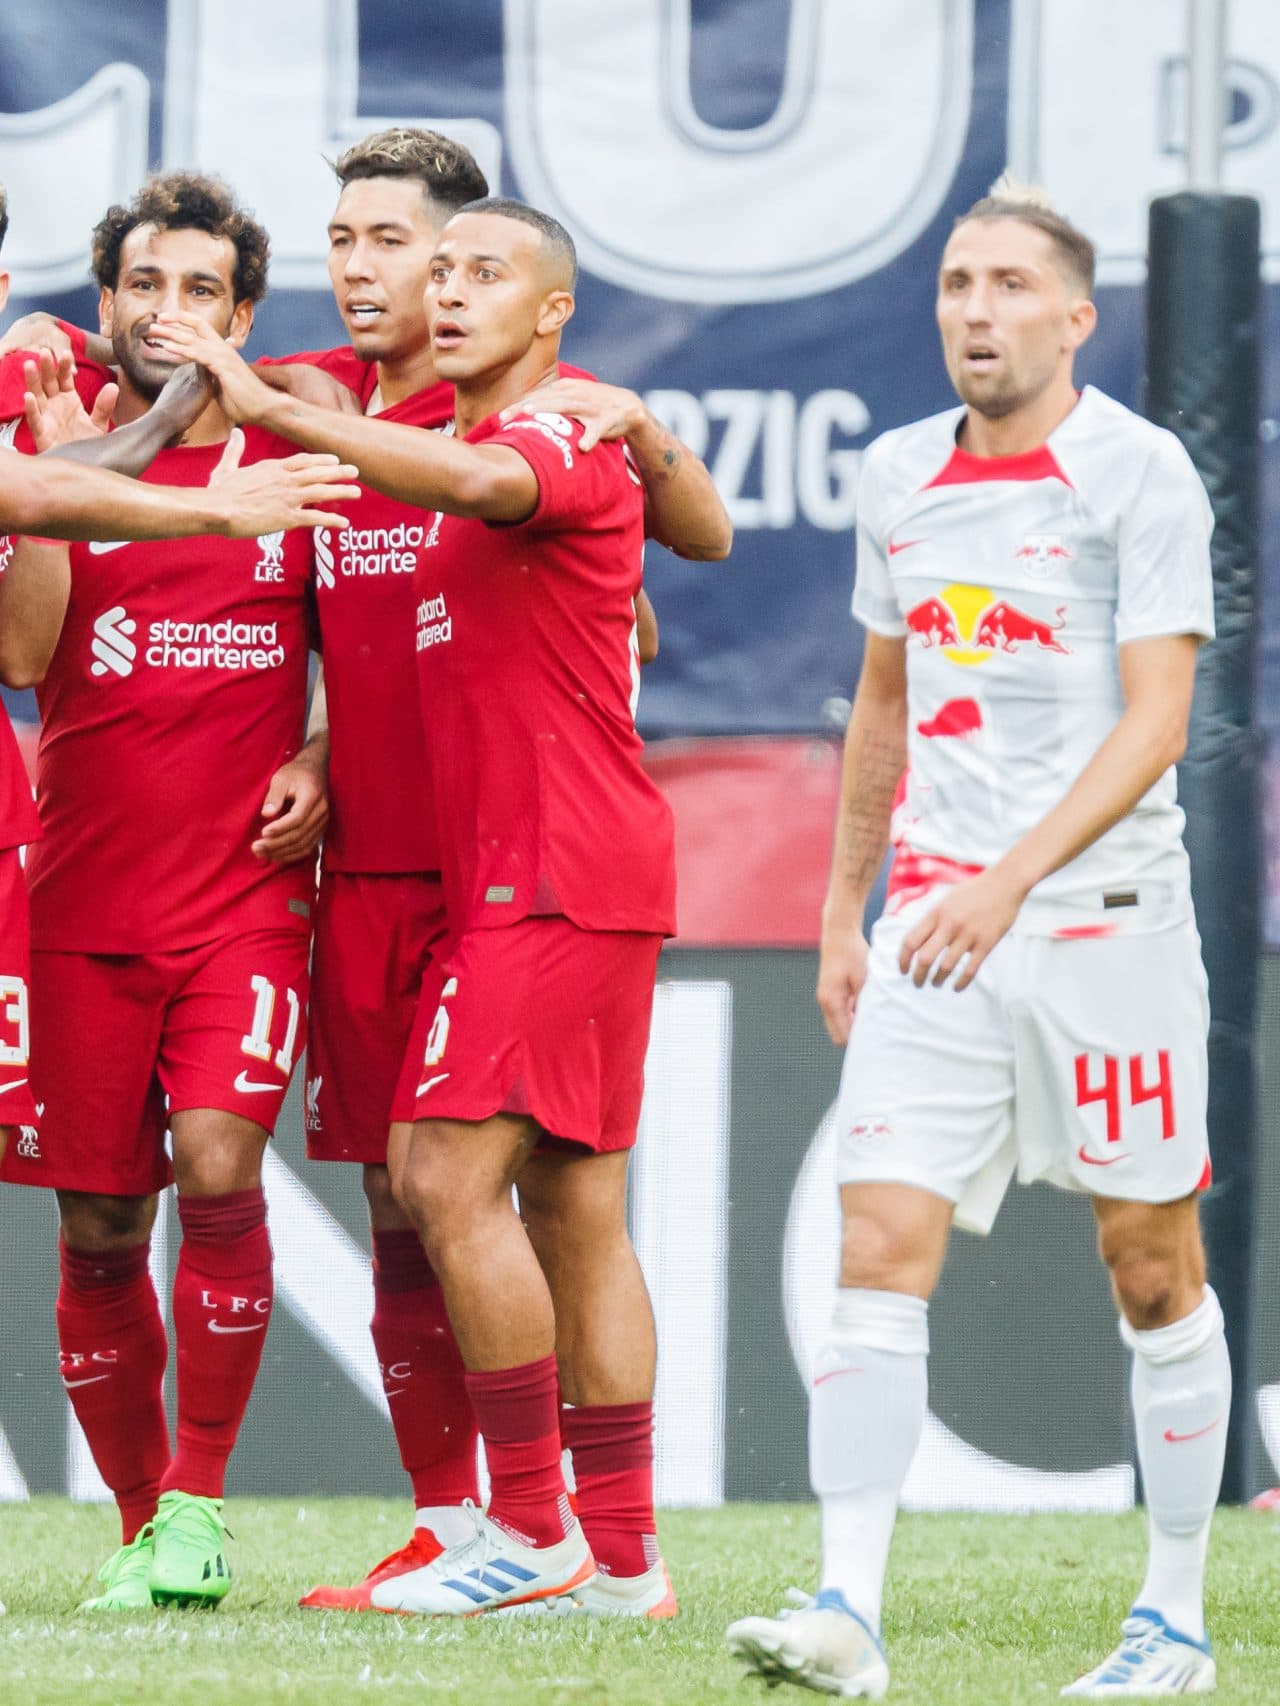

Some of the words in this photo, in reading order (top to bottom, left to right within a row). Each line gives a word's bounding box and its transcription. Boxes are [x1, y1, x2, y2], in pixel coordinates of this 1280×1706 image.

[145, 643, 285, 670] chartered
[148, 618, 277, 646] standard
[240, 974, 300, 1076] 11
[1074, 1050, 1176, 1143] 44
